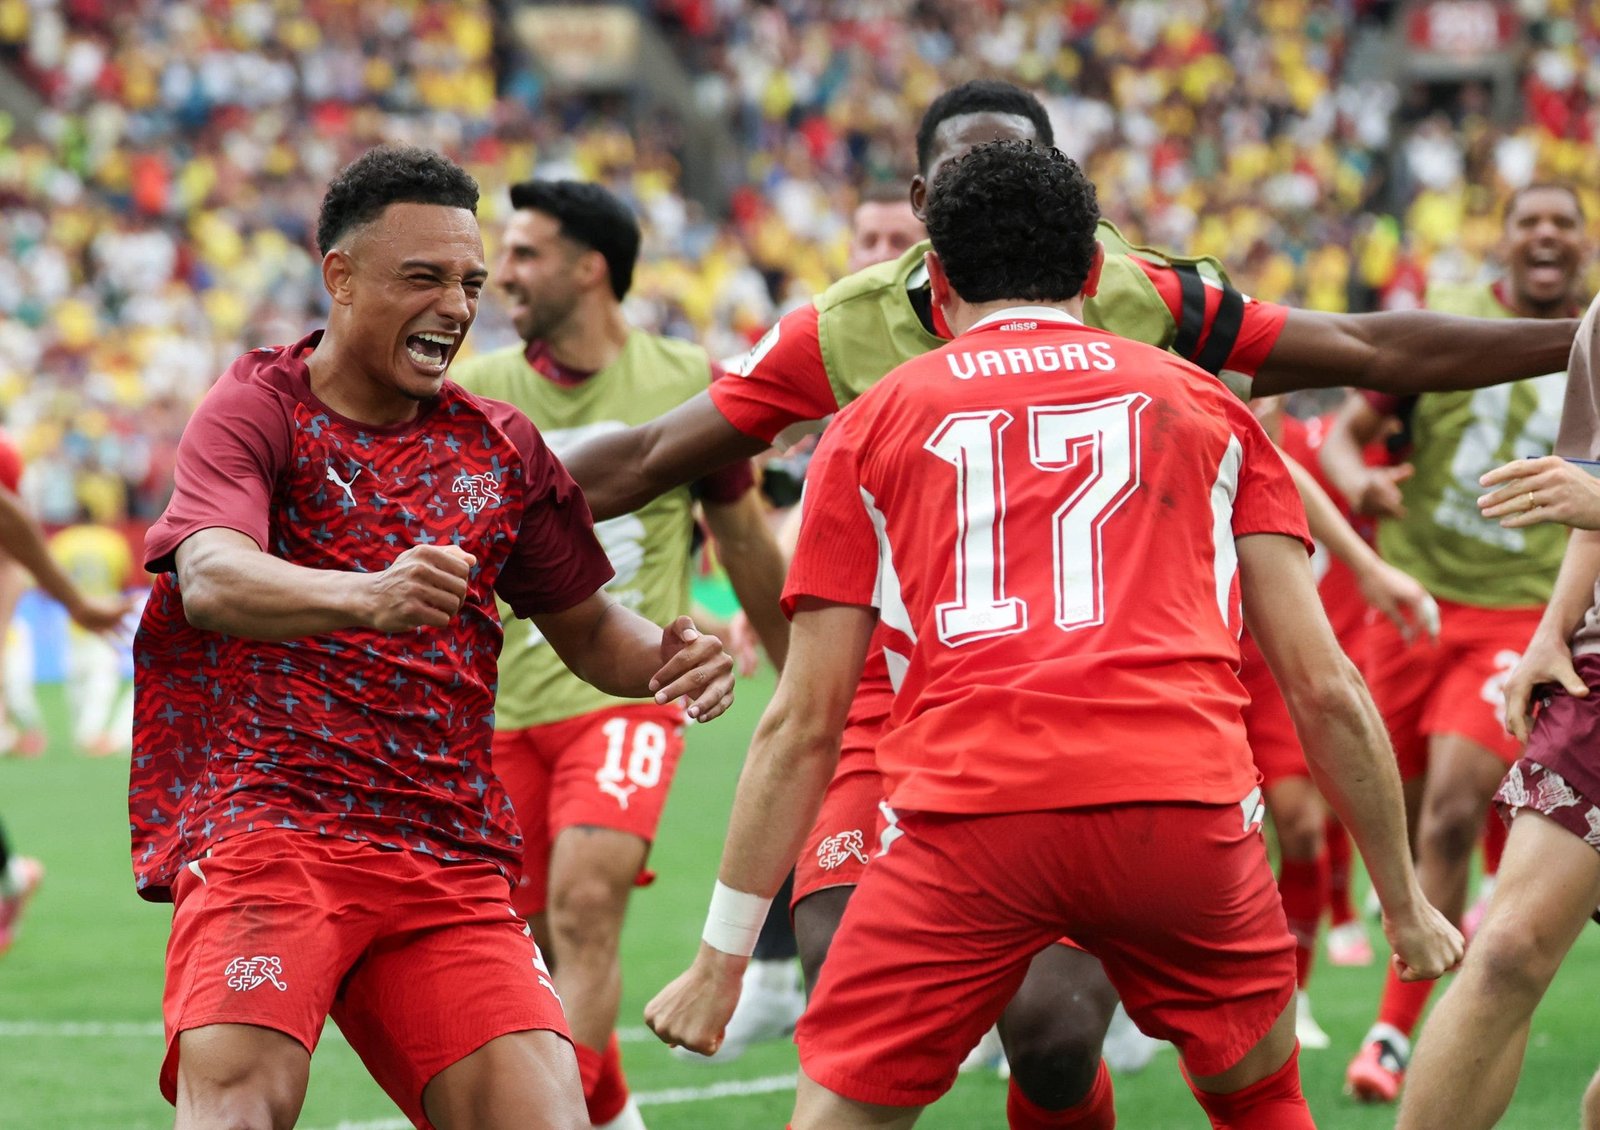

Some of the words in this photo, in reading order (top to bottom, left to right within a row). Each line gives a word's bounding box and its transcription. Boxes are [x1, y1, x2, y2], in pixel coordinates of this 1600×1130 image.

[946, 341, 1116, 380] VARGAS
[923, 391, 1152, 648] 17
[595, 716, 667, 789] 18
